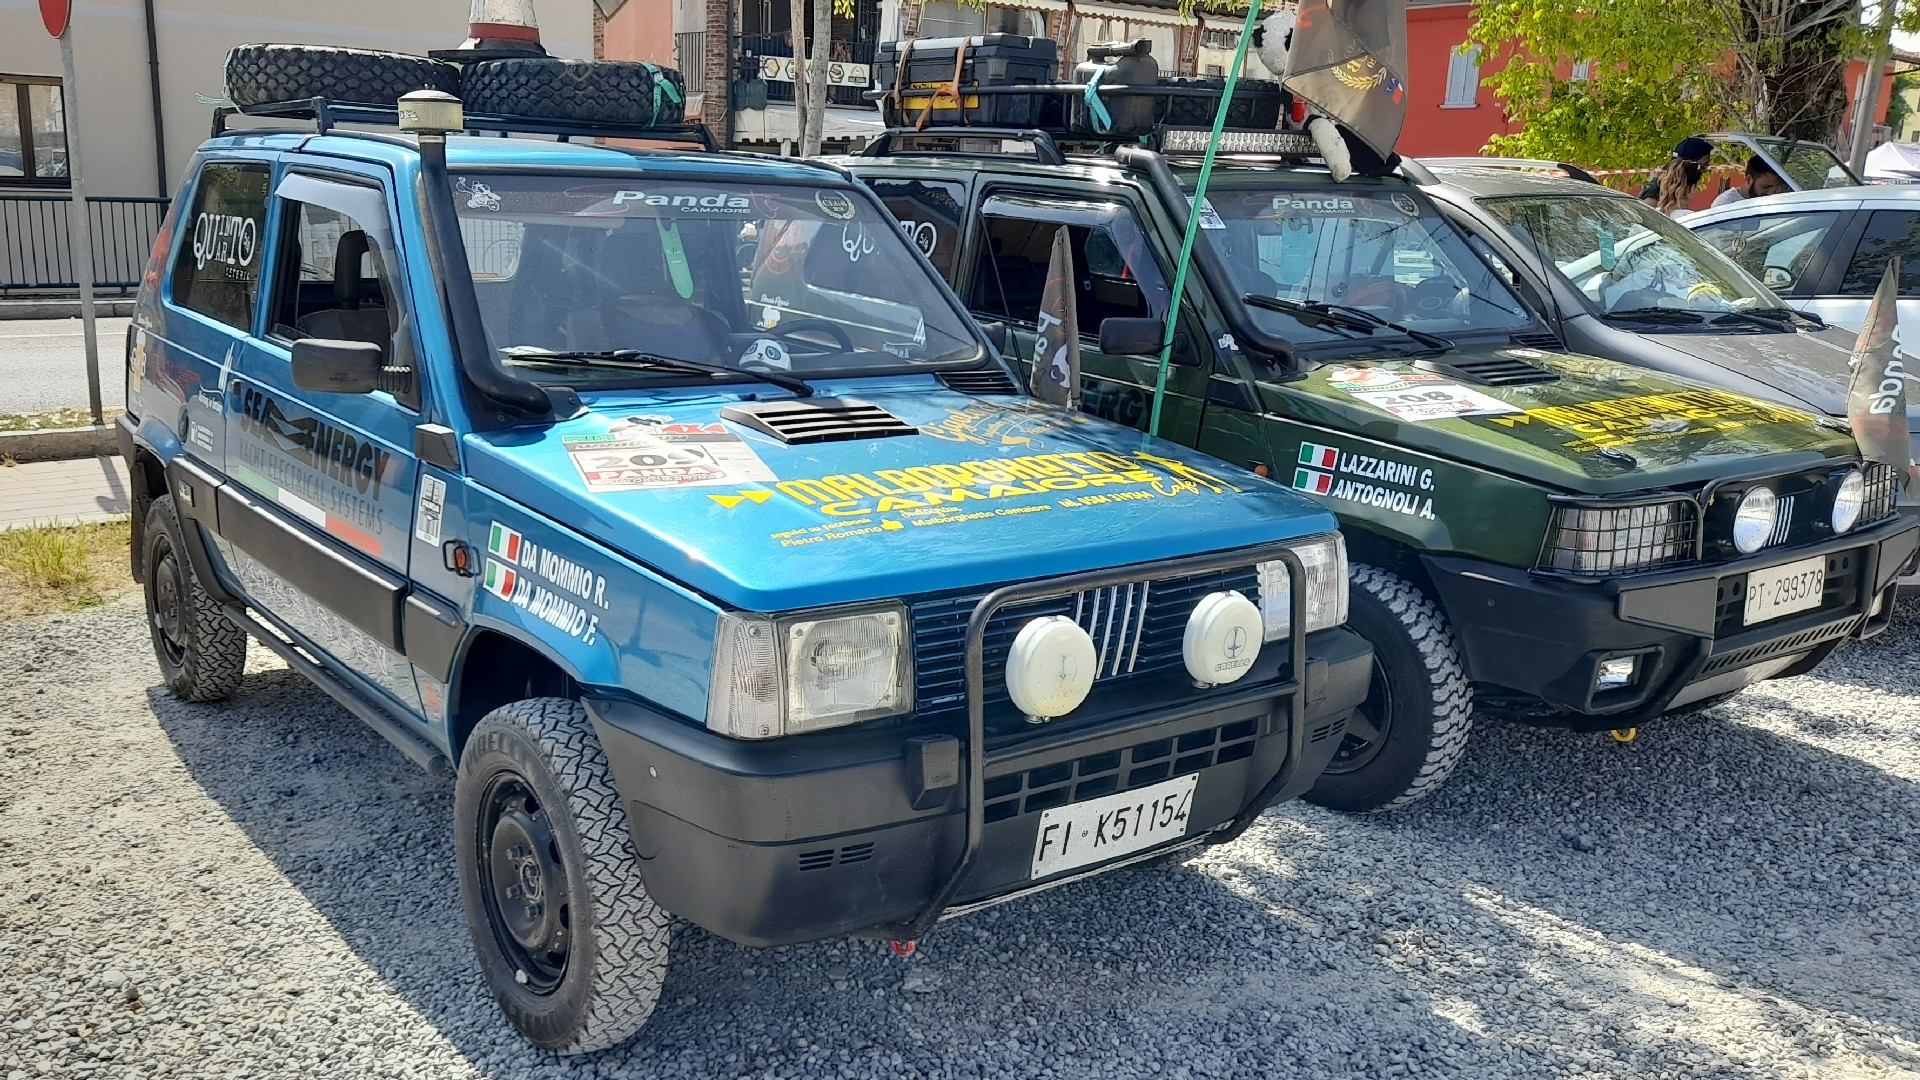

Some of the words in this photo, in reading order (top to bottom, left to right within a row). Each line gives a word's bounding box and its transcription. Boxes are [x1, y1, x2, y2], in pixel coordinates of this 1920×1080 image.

[613, 190, 750, 207] Panda
[1272, 198, 1354, 209] Panda
[1374, 391, 1454, 405] 208
[268, 453, 326, 507] ELECTRICAL
[331, 486, 384, 536] SYSTEMS
[775, 451, 1142, 505] MALBORGHETTO
[820, 470, 1163, 516] CAMAIORE
[1339, 452, 1419, 486] LAZZARINI
[1420, 468, 1436, 492] G.
[1332, 479, 1418, 515] ANTOGNOLI
[1418, 497, 1437, 521] A.
[780, 535, 825, 548] Pietro
[826, 525, 884, 541] Romano
[521, 539, 538, 574] DA
[539, 547, 593, 600] MOMMIO
[593, 575, 611, 611] R.
[1747, 581, 1766, 614] PT
[1773, 569, 1825, 607] 299378
[512, 576, 533, 610] DA
[528, 585, 587, 637] MOMMIO
[583, 613, 600, 647] F.
[1038, 822, 1072, 862] FI
[1093, 788, 1194, 848] K51154
